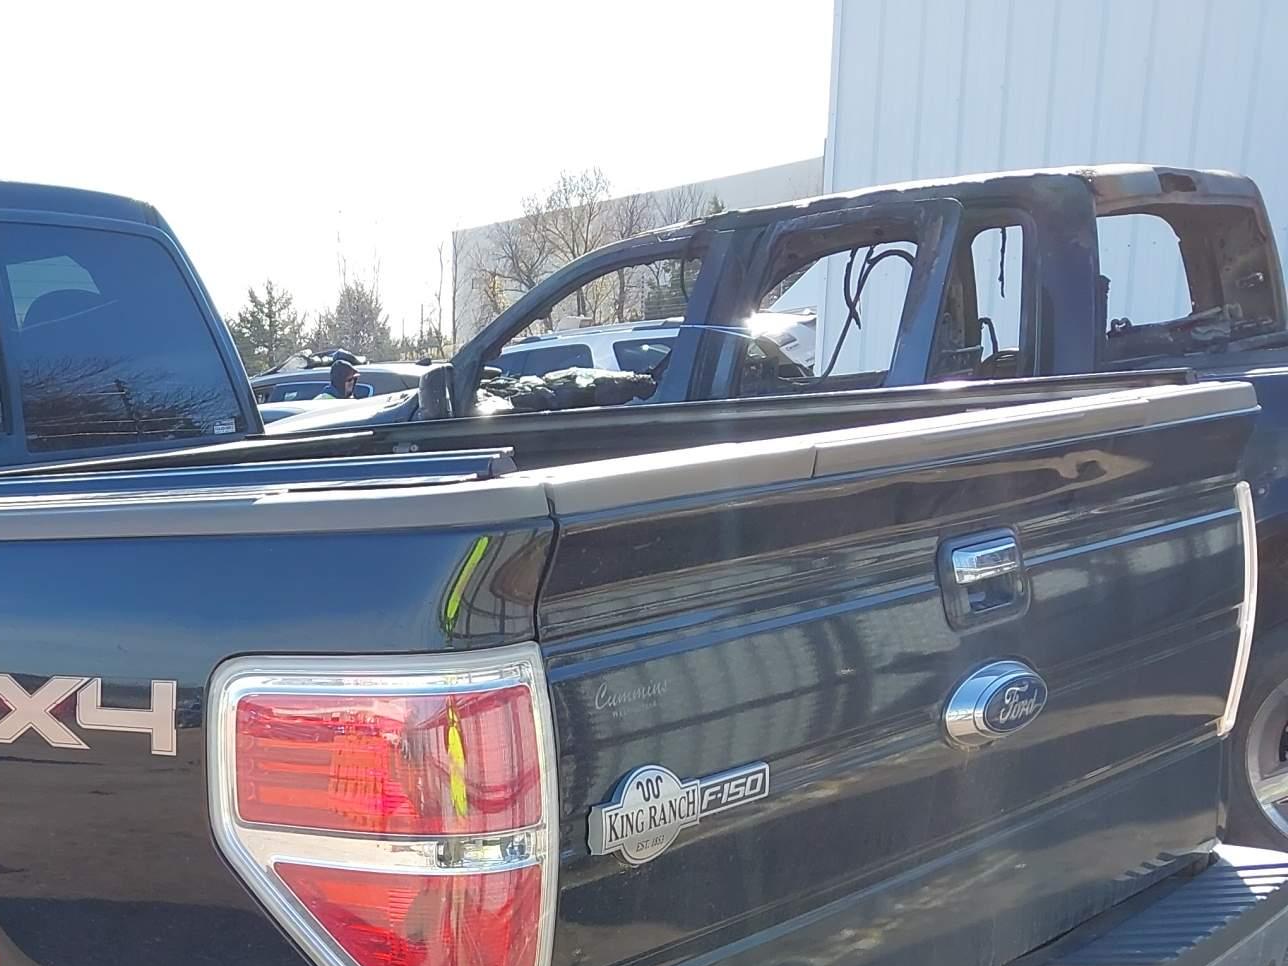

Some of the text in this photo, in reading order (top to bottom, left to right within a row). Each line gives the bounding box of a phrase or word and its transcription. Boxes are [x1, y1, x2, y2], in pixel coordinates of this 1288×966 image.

[999, 683, 1043, 724] Ford
[701, 772, 764, 811] F-150
[608, 788, 696, 843] KING RANCH
